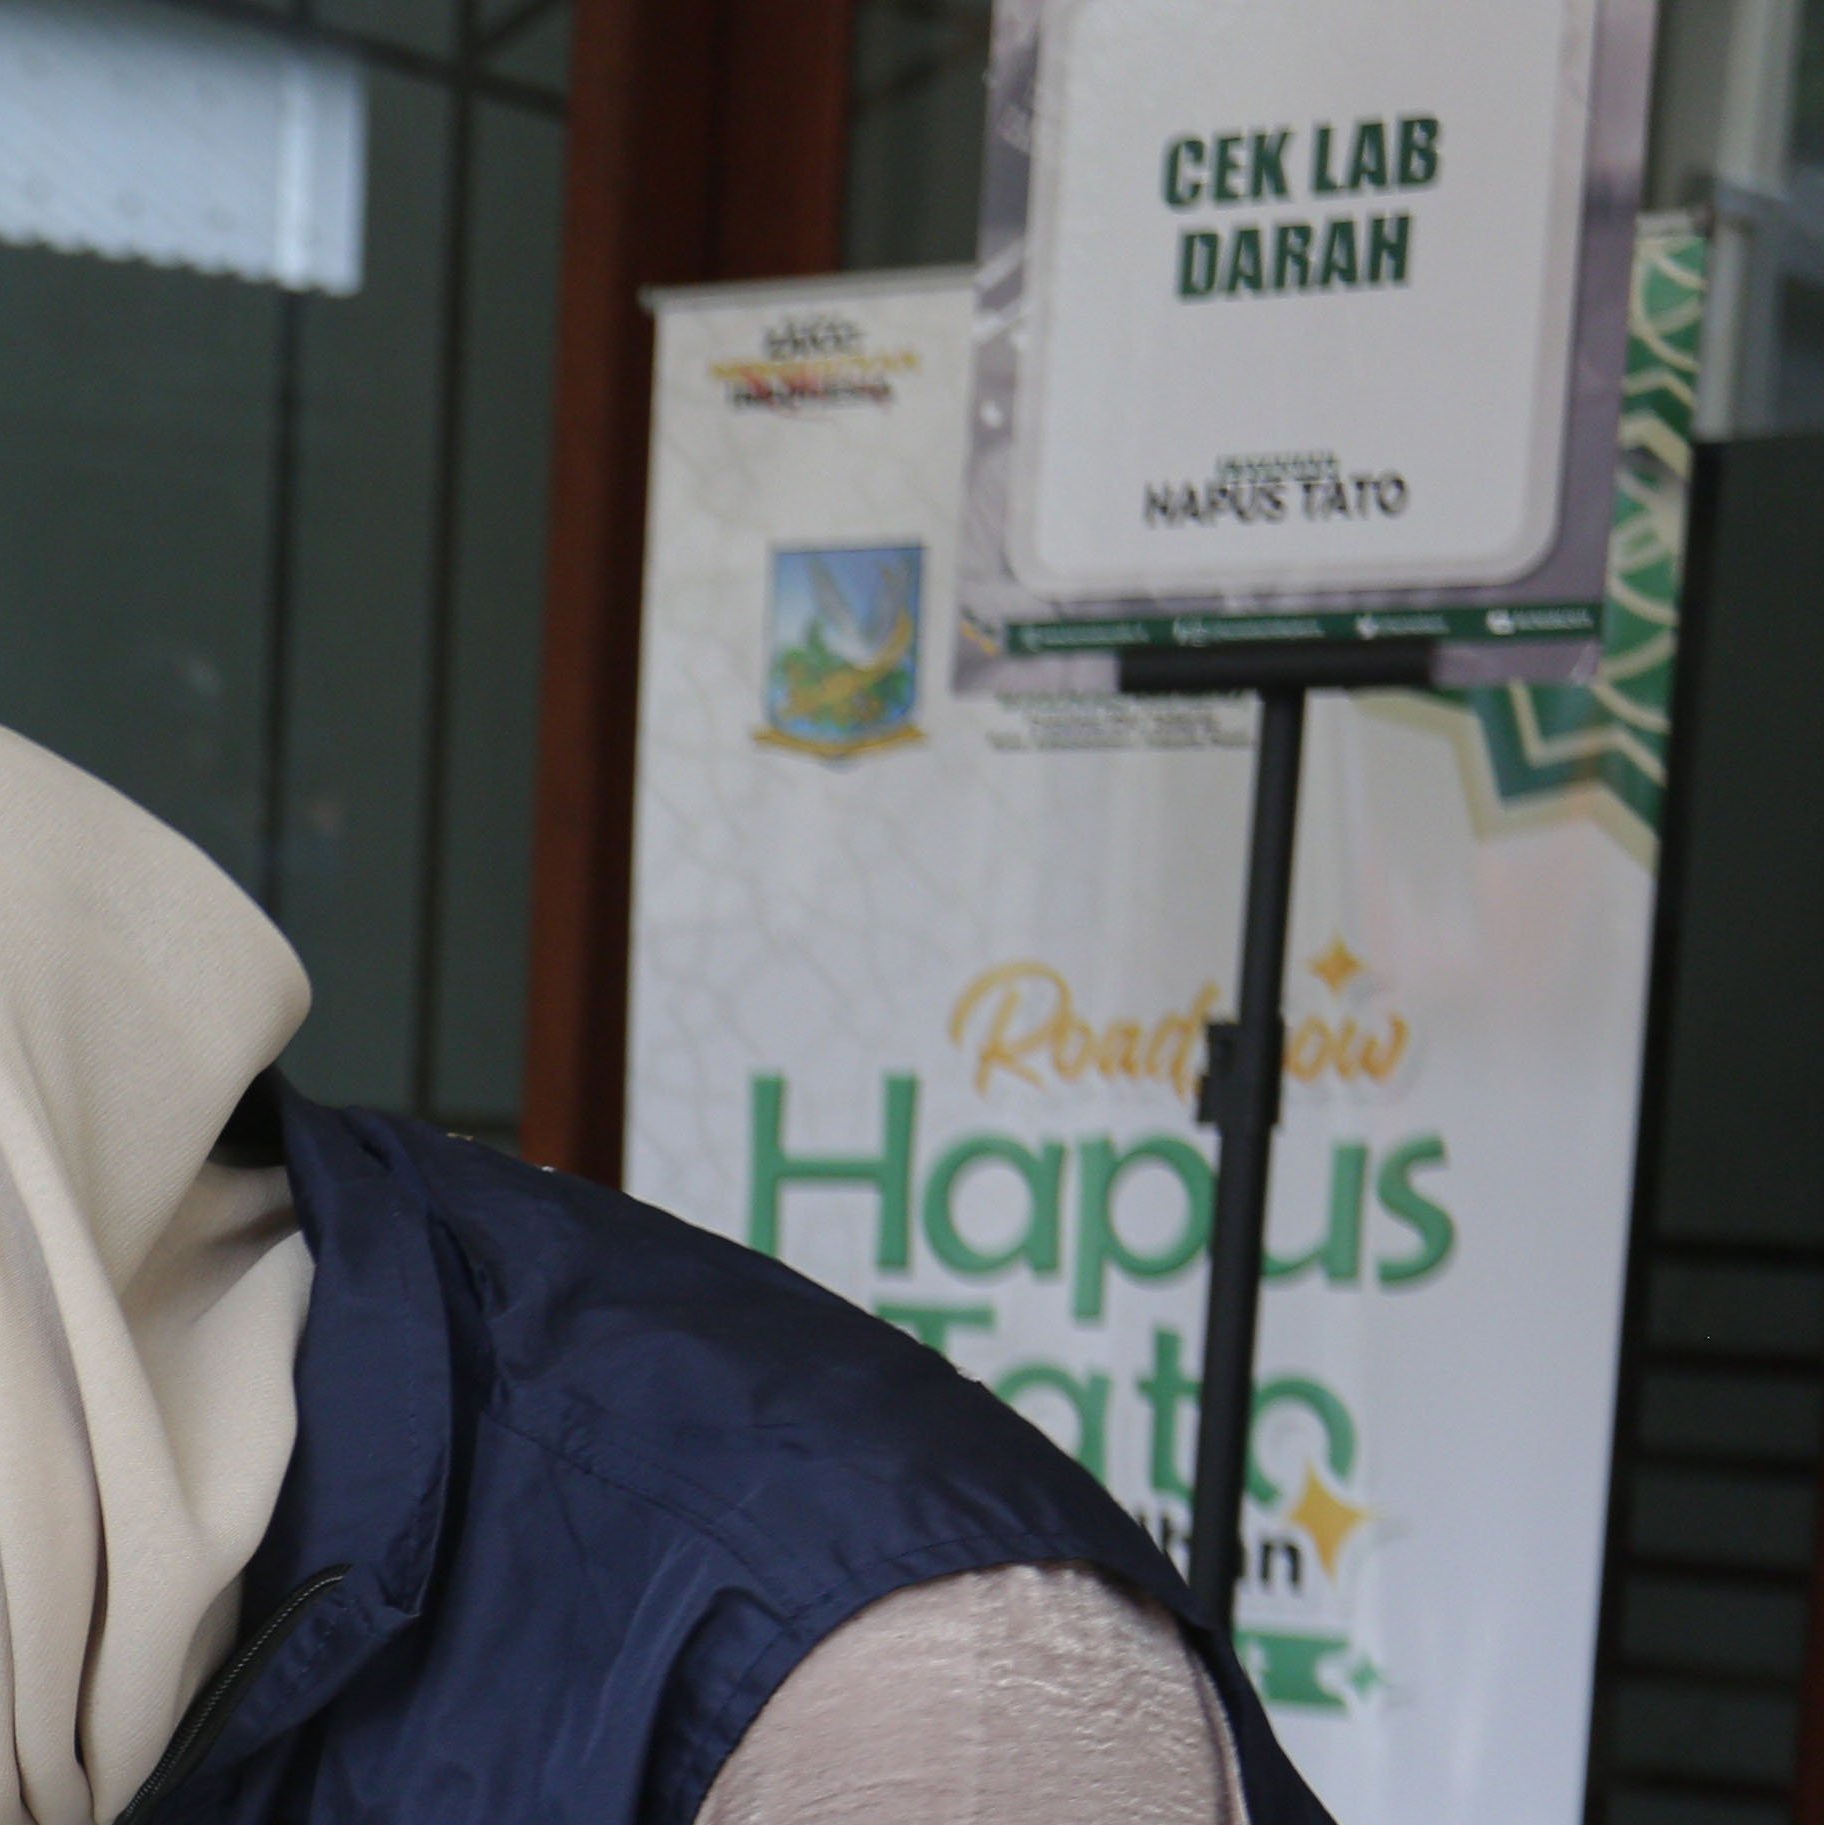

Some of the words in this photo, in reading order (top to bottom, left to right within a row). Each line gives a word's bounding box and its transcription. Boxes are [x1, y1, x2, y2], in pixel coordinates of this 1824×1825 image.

[1161, 125, 1296, 208] CEK
[1309, 113, 1443, 194] LAB
[1175, 211, 1416, 302] DARAH
[1298, 468, 1411, 522] TATO
[949, 958, 1412, 1106] Roadow
[750, 1069, 1459, 1322] Hapus
